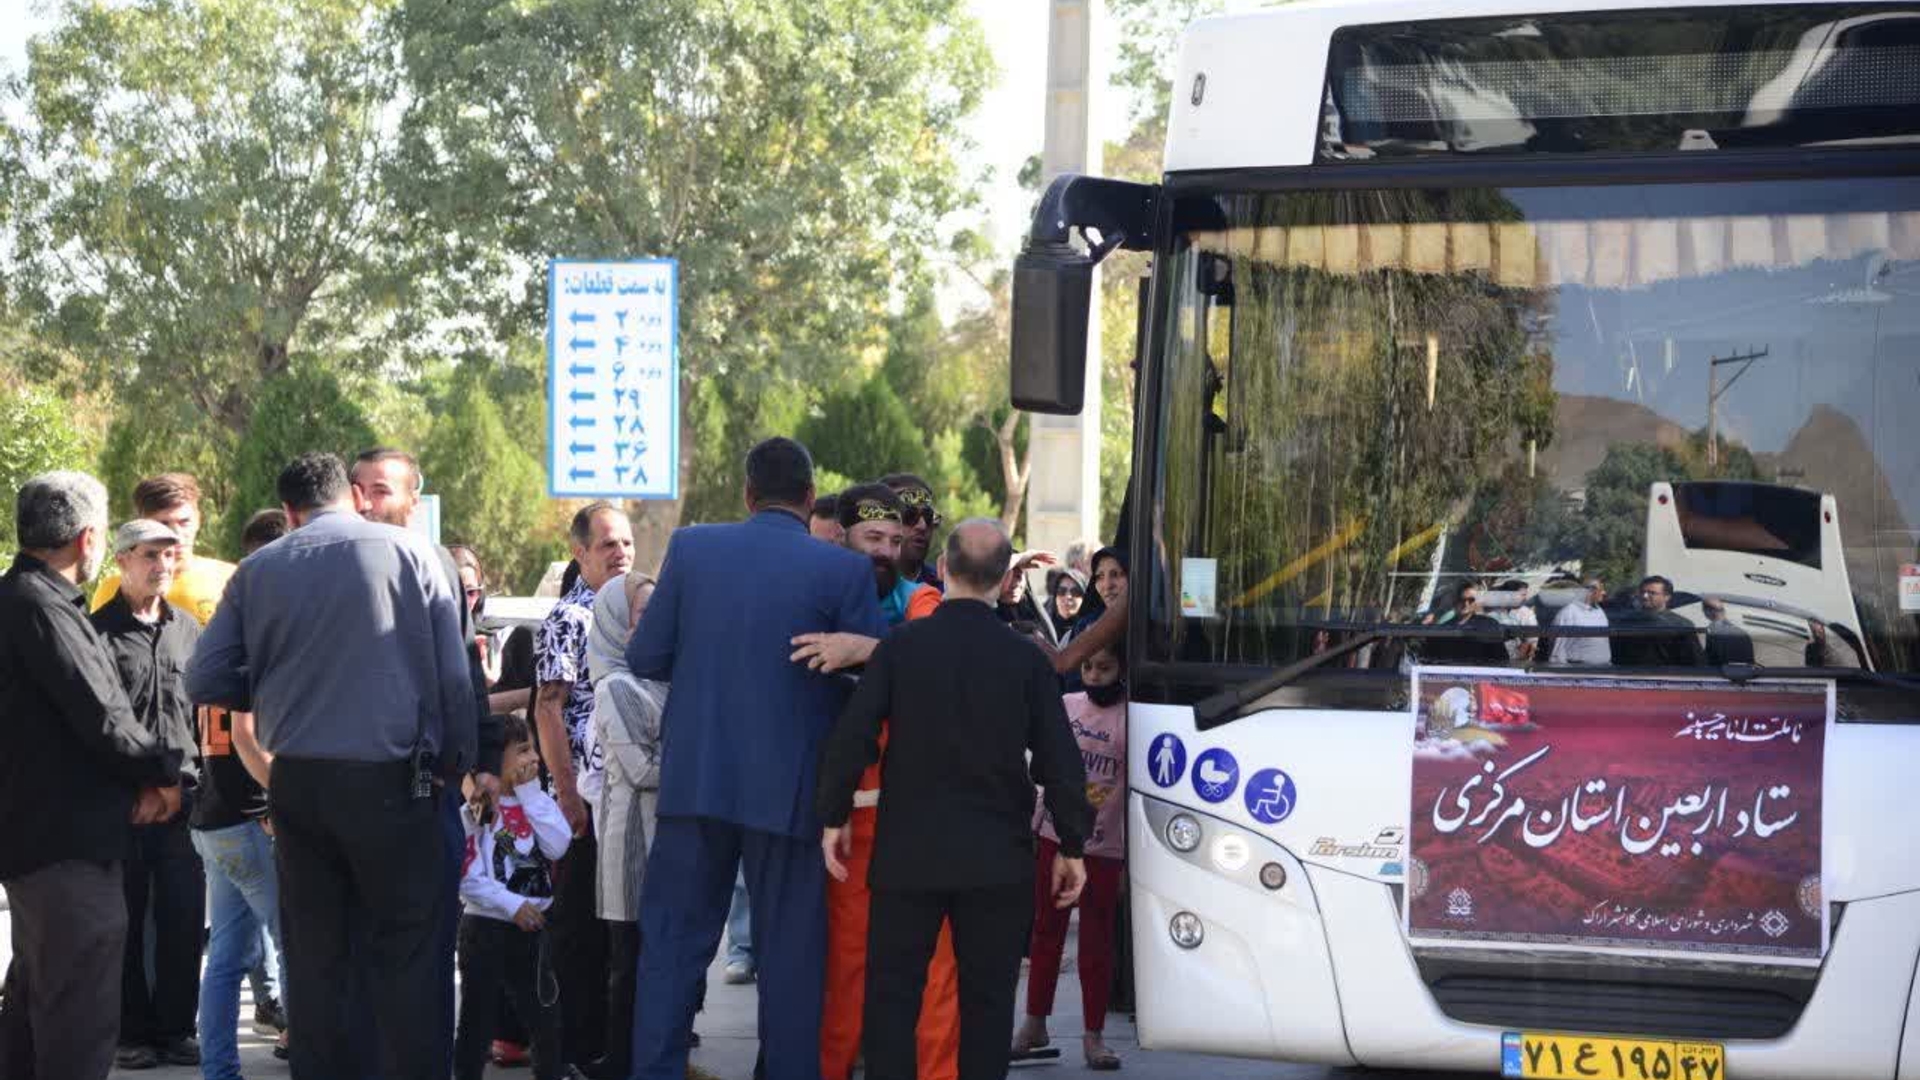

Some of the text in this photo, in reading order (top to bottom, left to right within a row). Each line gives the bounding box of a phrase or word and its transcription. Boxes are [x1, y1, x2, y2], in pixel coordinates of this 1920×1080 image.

[617, 277, 649, 295] سمت
[614, 309, 629, 329] ۲
[614, 334, 630, 356] ۴
[612, 360, 625, 381] ۶
[1432, 745, 1799, 858] ستاد اربعین استان مرکزی
[1637, 914, 1670, 931] اسلامی
[1711, 911, 1755, 934] شهرداری
[1611, 1045, 1672, 1080] ۱۹۵
[1680, 1056, 1720, 1080] ۴۷
